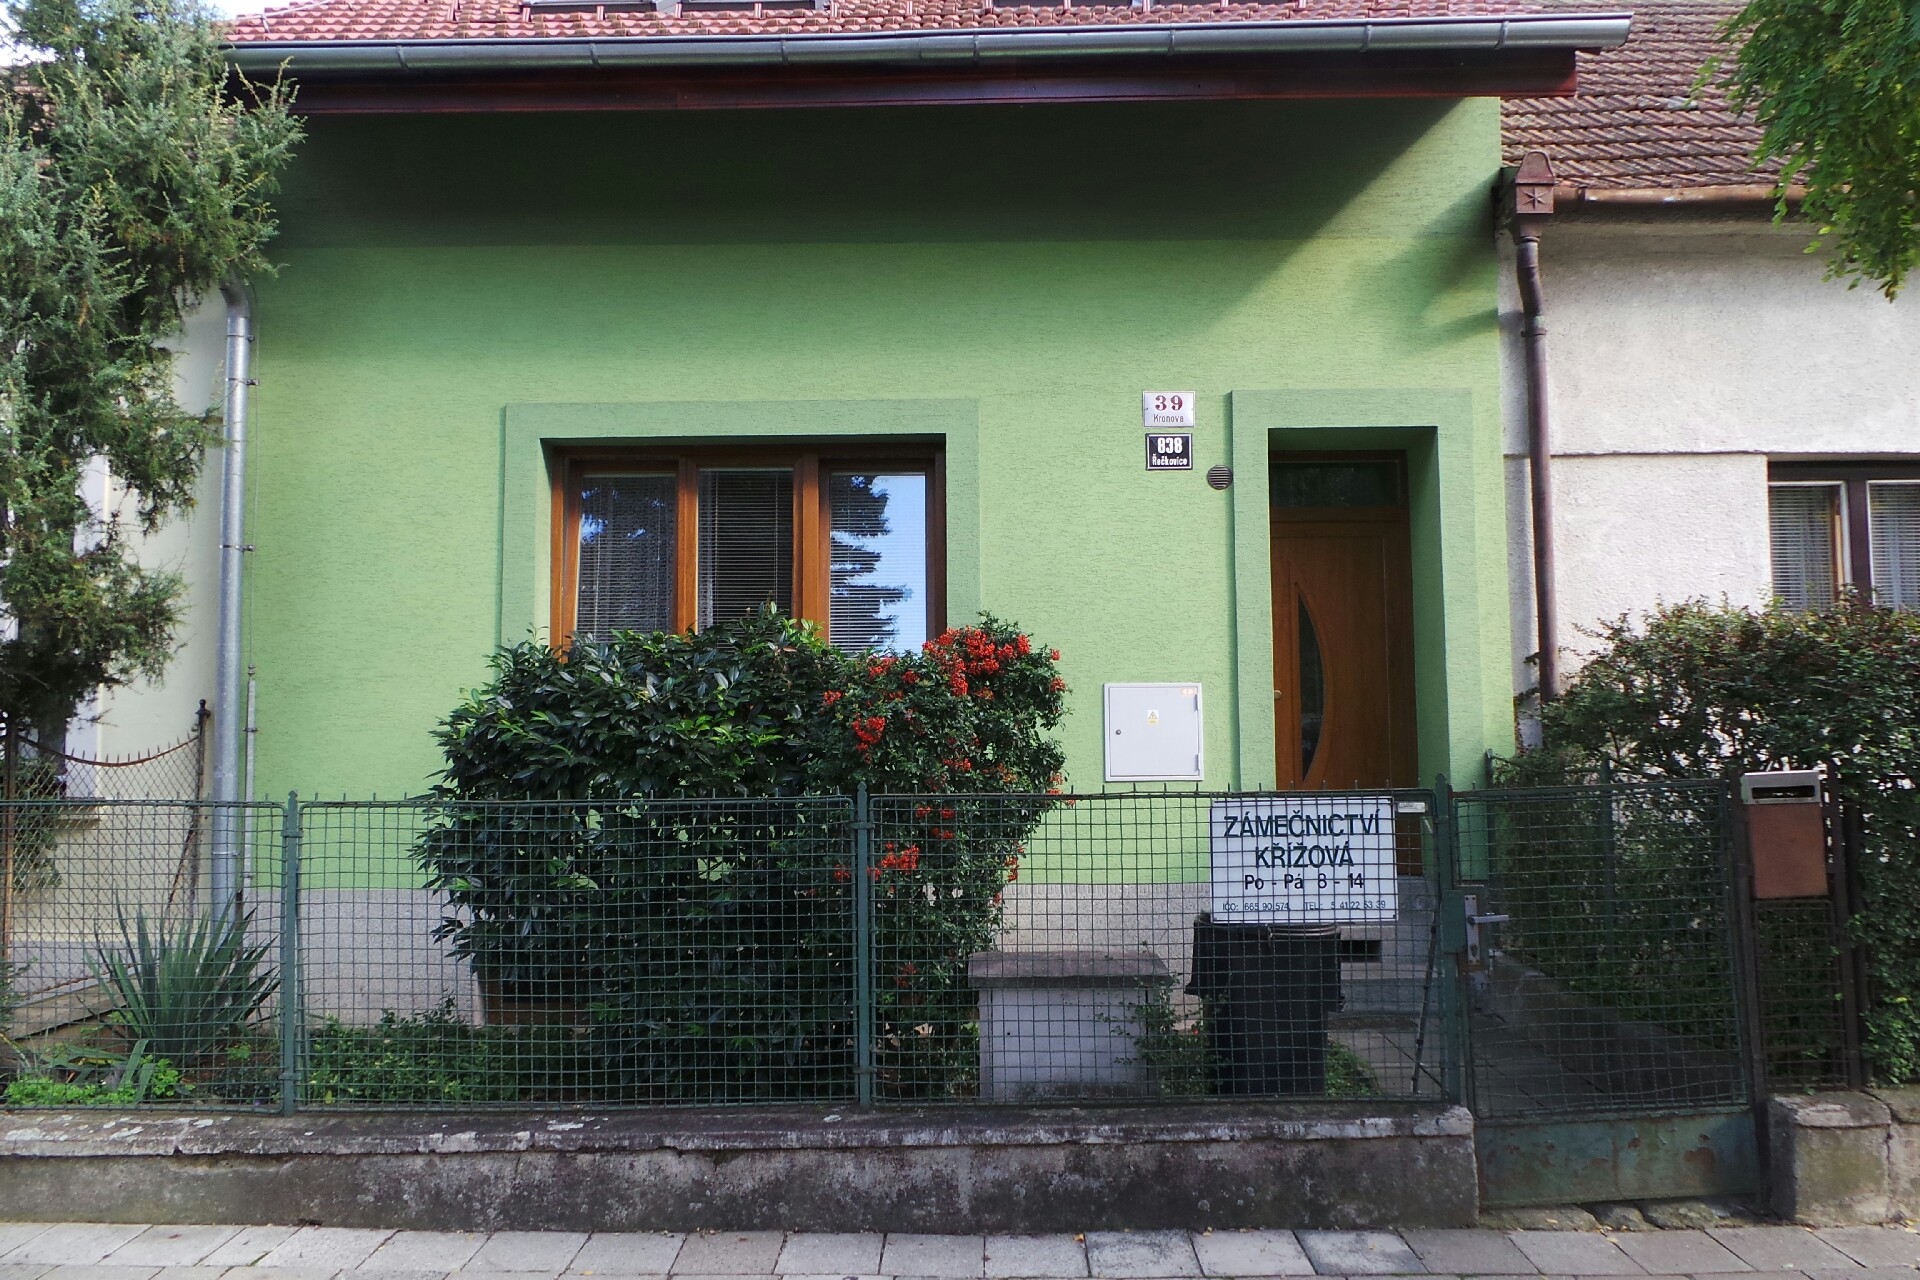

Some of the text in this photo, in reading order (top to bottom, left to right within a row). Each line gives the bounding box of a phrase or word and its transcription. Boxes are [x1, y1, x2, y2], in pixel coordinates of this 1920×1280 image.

[1155, 395, 1183, 411] 39
[1153, 413, 1184, 423] Kronova
[1157, 437, 1183, 454] 838
[1223, 808, 1381, 838] ZÁMEČNICTVÍ
[1255, 840, 1355, 869] KŘÍŽOVÁ
[1244, 874, 1265, 891] Po
[1284, 873, 1304, 890] Pá
[1317, 873, 1328, 889] 8
[1348, 872, 1364, 889] 14
